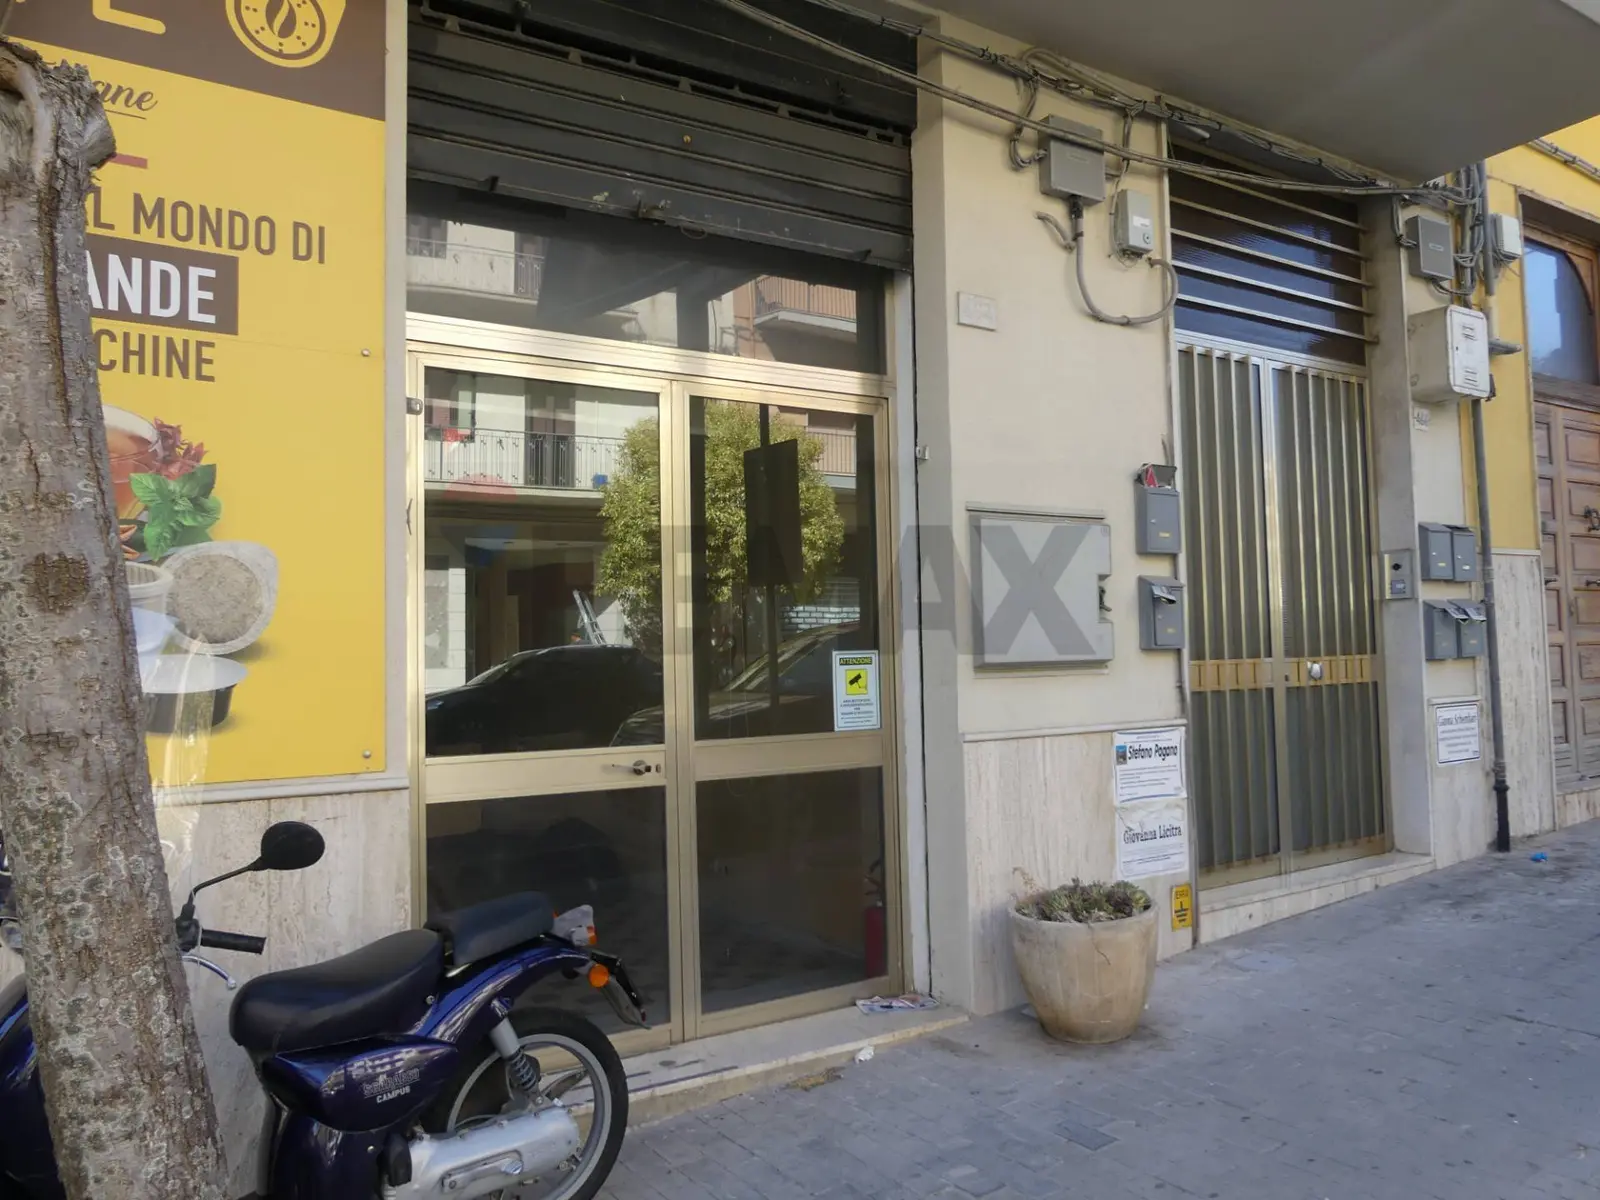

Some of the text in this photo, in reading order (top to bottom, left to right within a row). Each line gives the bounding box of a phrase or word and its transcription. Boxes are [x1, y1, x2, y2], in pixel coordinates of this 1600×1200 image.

[83, 186, 325, 264] L MONDO DI
[840, 657, 872, 666] ATTENZIONE
[376, 1085, 411, 1103] CAMPUS
